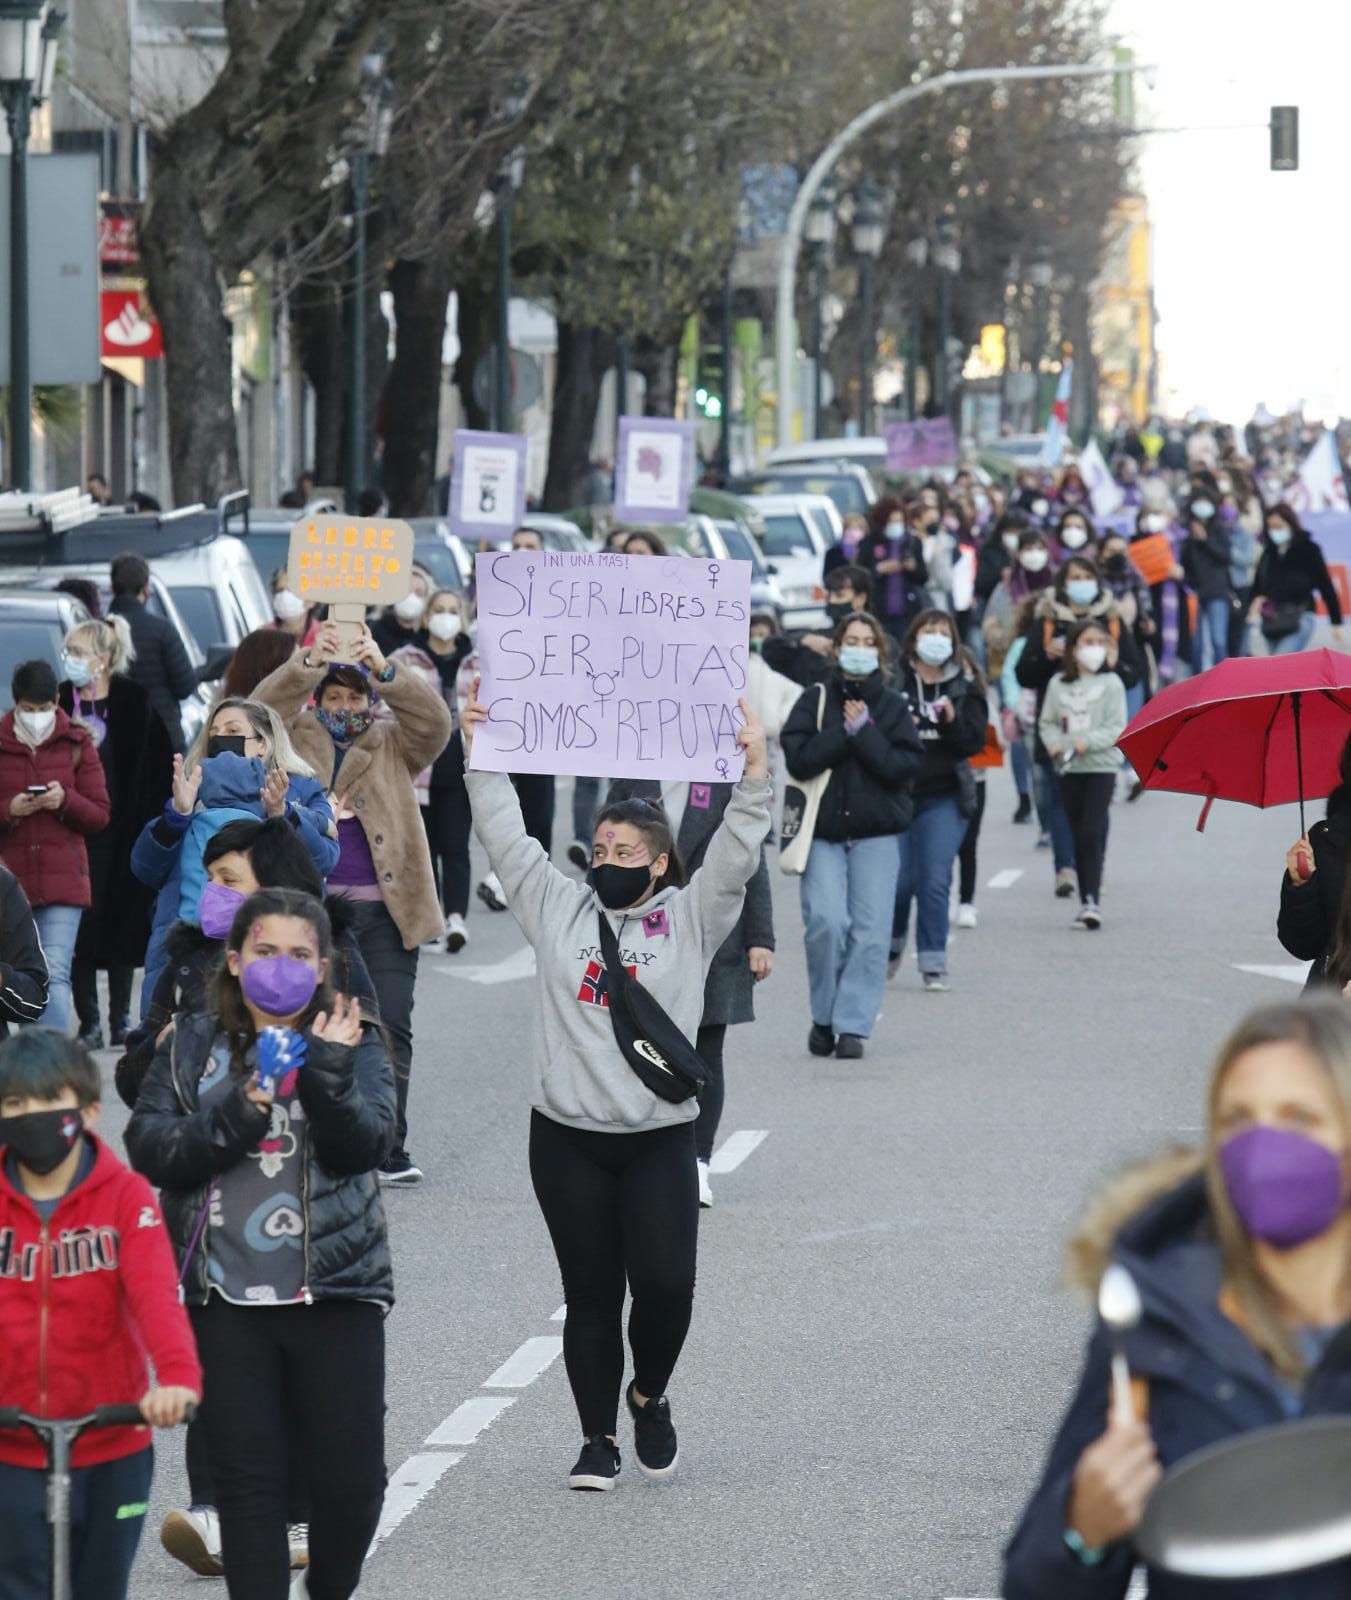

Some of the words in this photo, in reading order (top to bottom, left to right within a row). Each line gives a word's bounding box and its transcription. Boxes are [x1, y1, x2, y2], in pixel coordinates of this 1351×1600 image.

[570, 554, 594, 568] UNA
[598, 553, 629, 570] MÁS!
[543, 580, 608, 619] SER
[715, 600, 746, 621] ES
[496, 629, 594, 681] SER
[621, 636, 746, 690] PUTAS
[487, 697, 598, 754] SOMOS
[616, 698, 744, 761] REPUTAS
